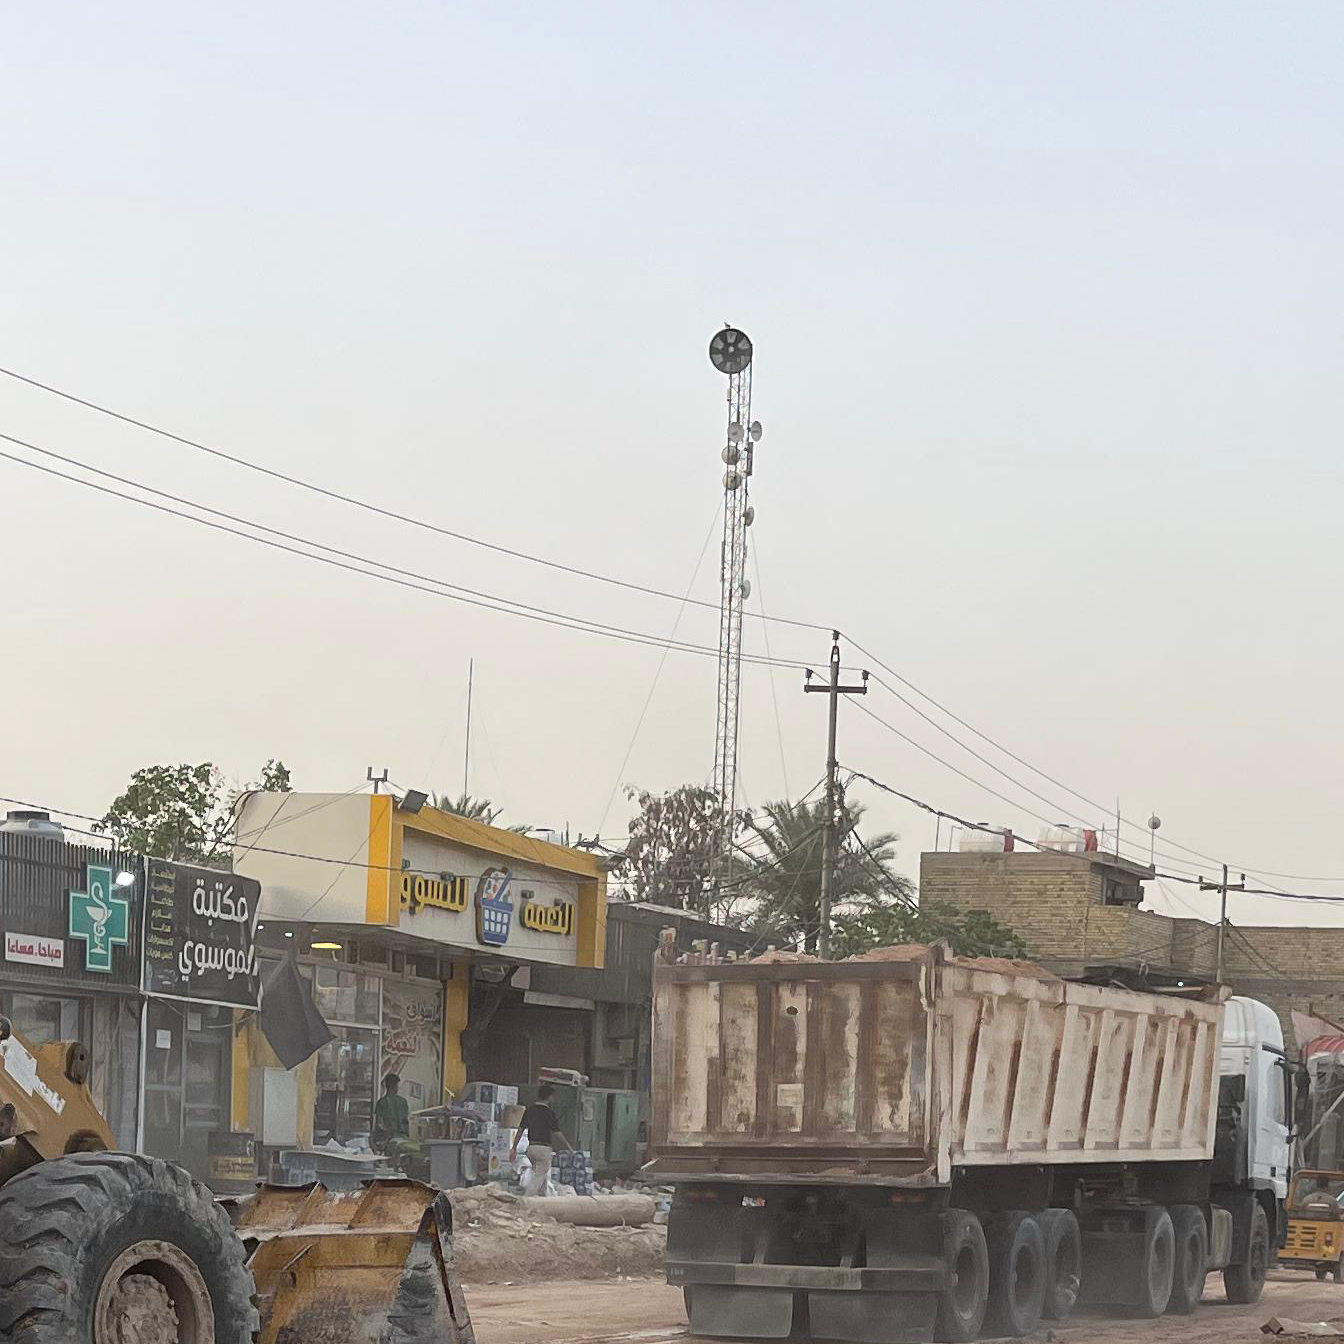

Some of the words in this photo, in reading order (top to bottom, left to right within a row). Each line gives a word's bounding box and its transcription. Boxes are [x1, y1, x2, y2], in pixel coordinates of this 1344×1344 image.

[193, 878, 249, 926] مكتبة
[523, 889, 575, 935] النعمة
[178, 940, 258, 982] الموسوي
